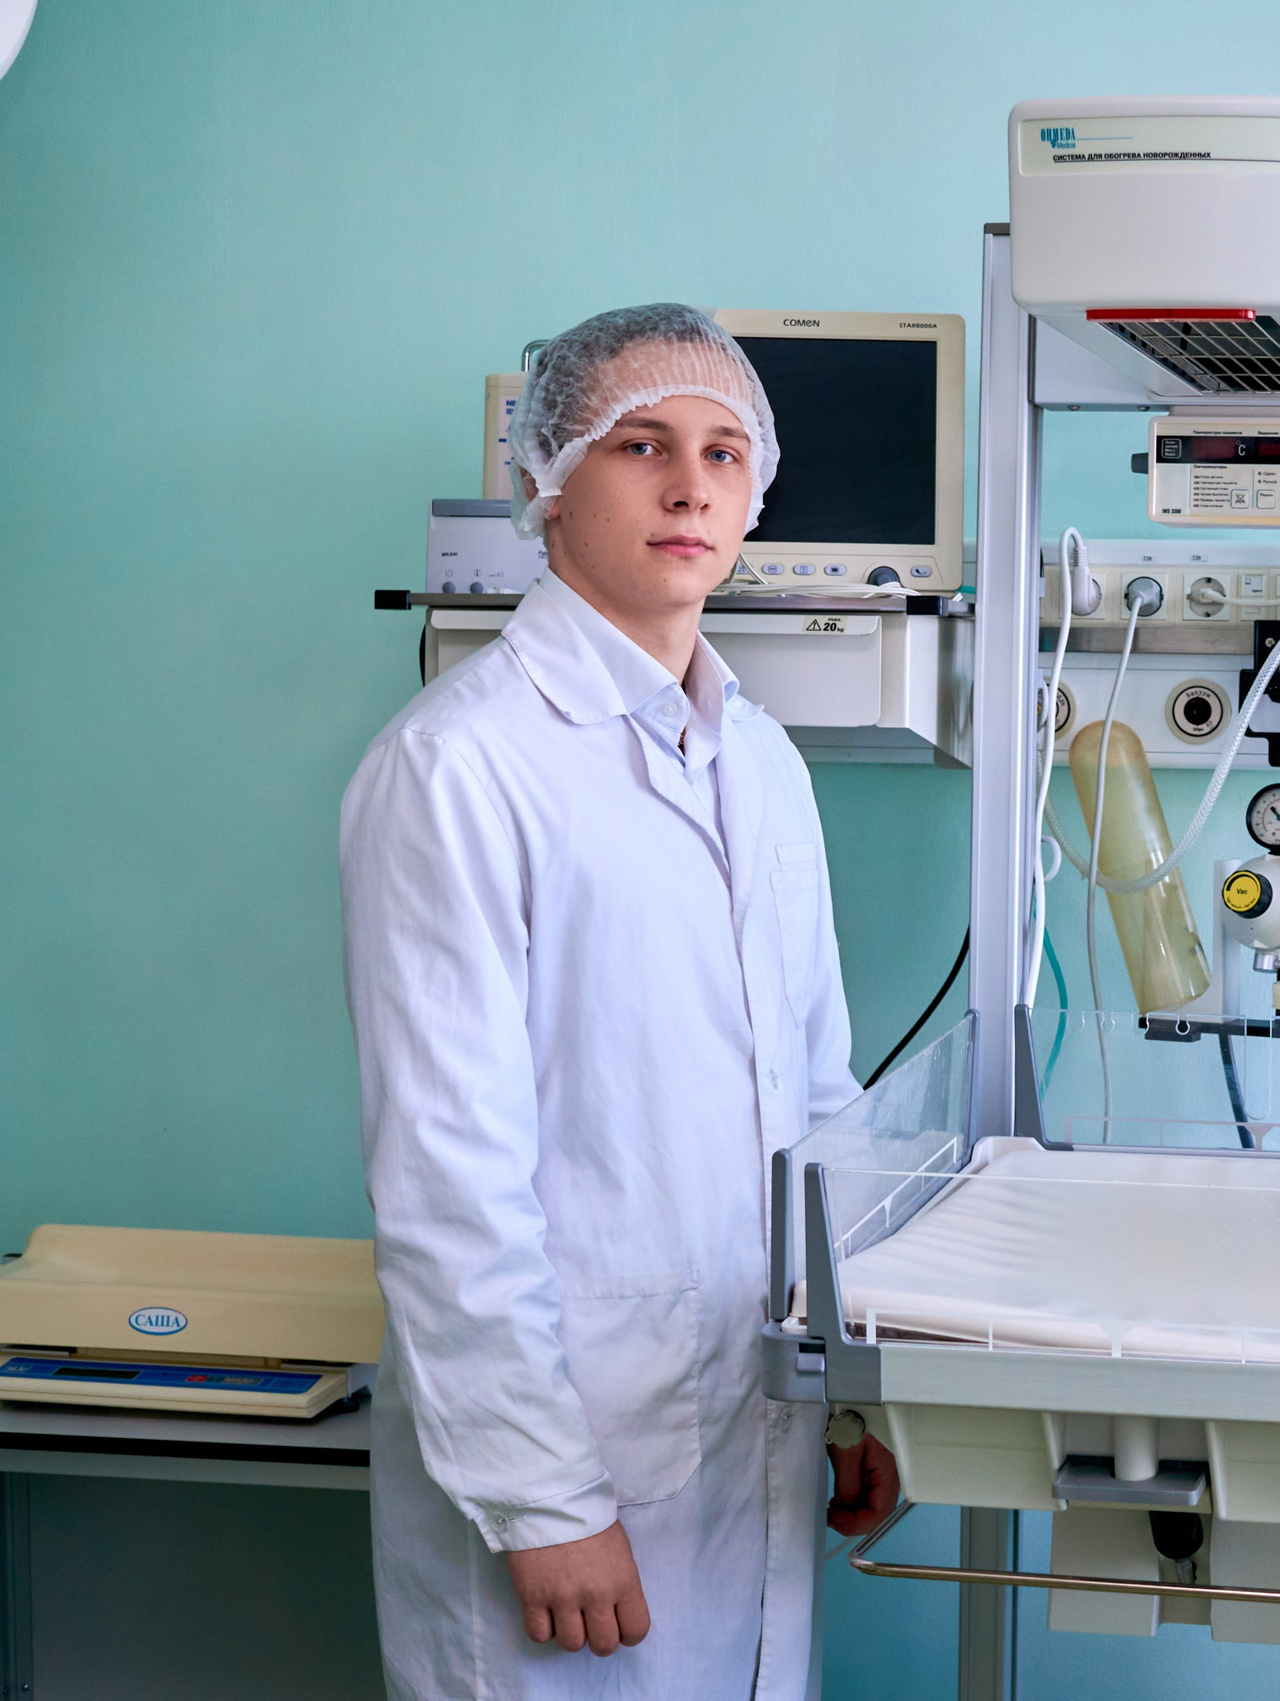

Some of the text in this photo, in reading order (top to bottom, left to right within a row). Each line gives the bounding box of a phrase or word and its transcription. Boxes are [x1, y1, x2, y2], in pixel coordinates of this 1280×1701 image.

[1040, 127, 1076, 142] OHMEDA
[823, 623, 837, 632] 20
[134, 1314, 182, 1328] САША
